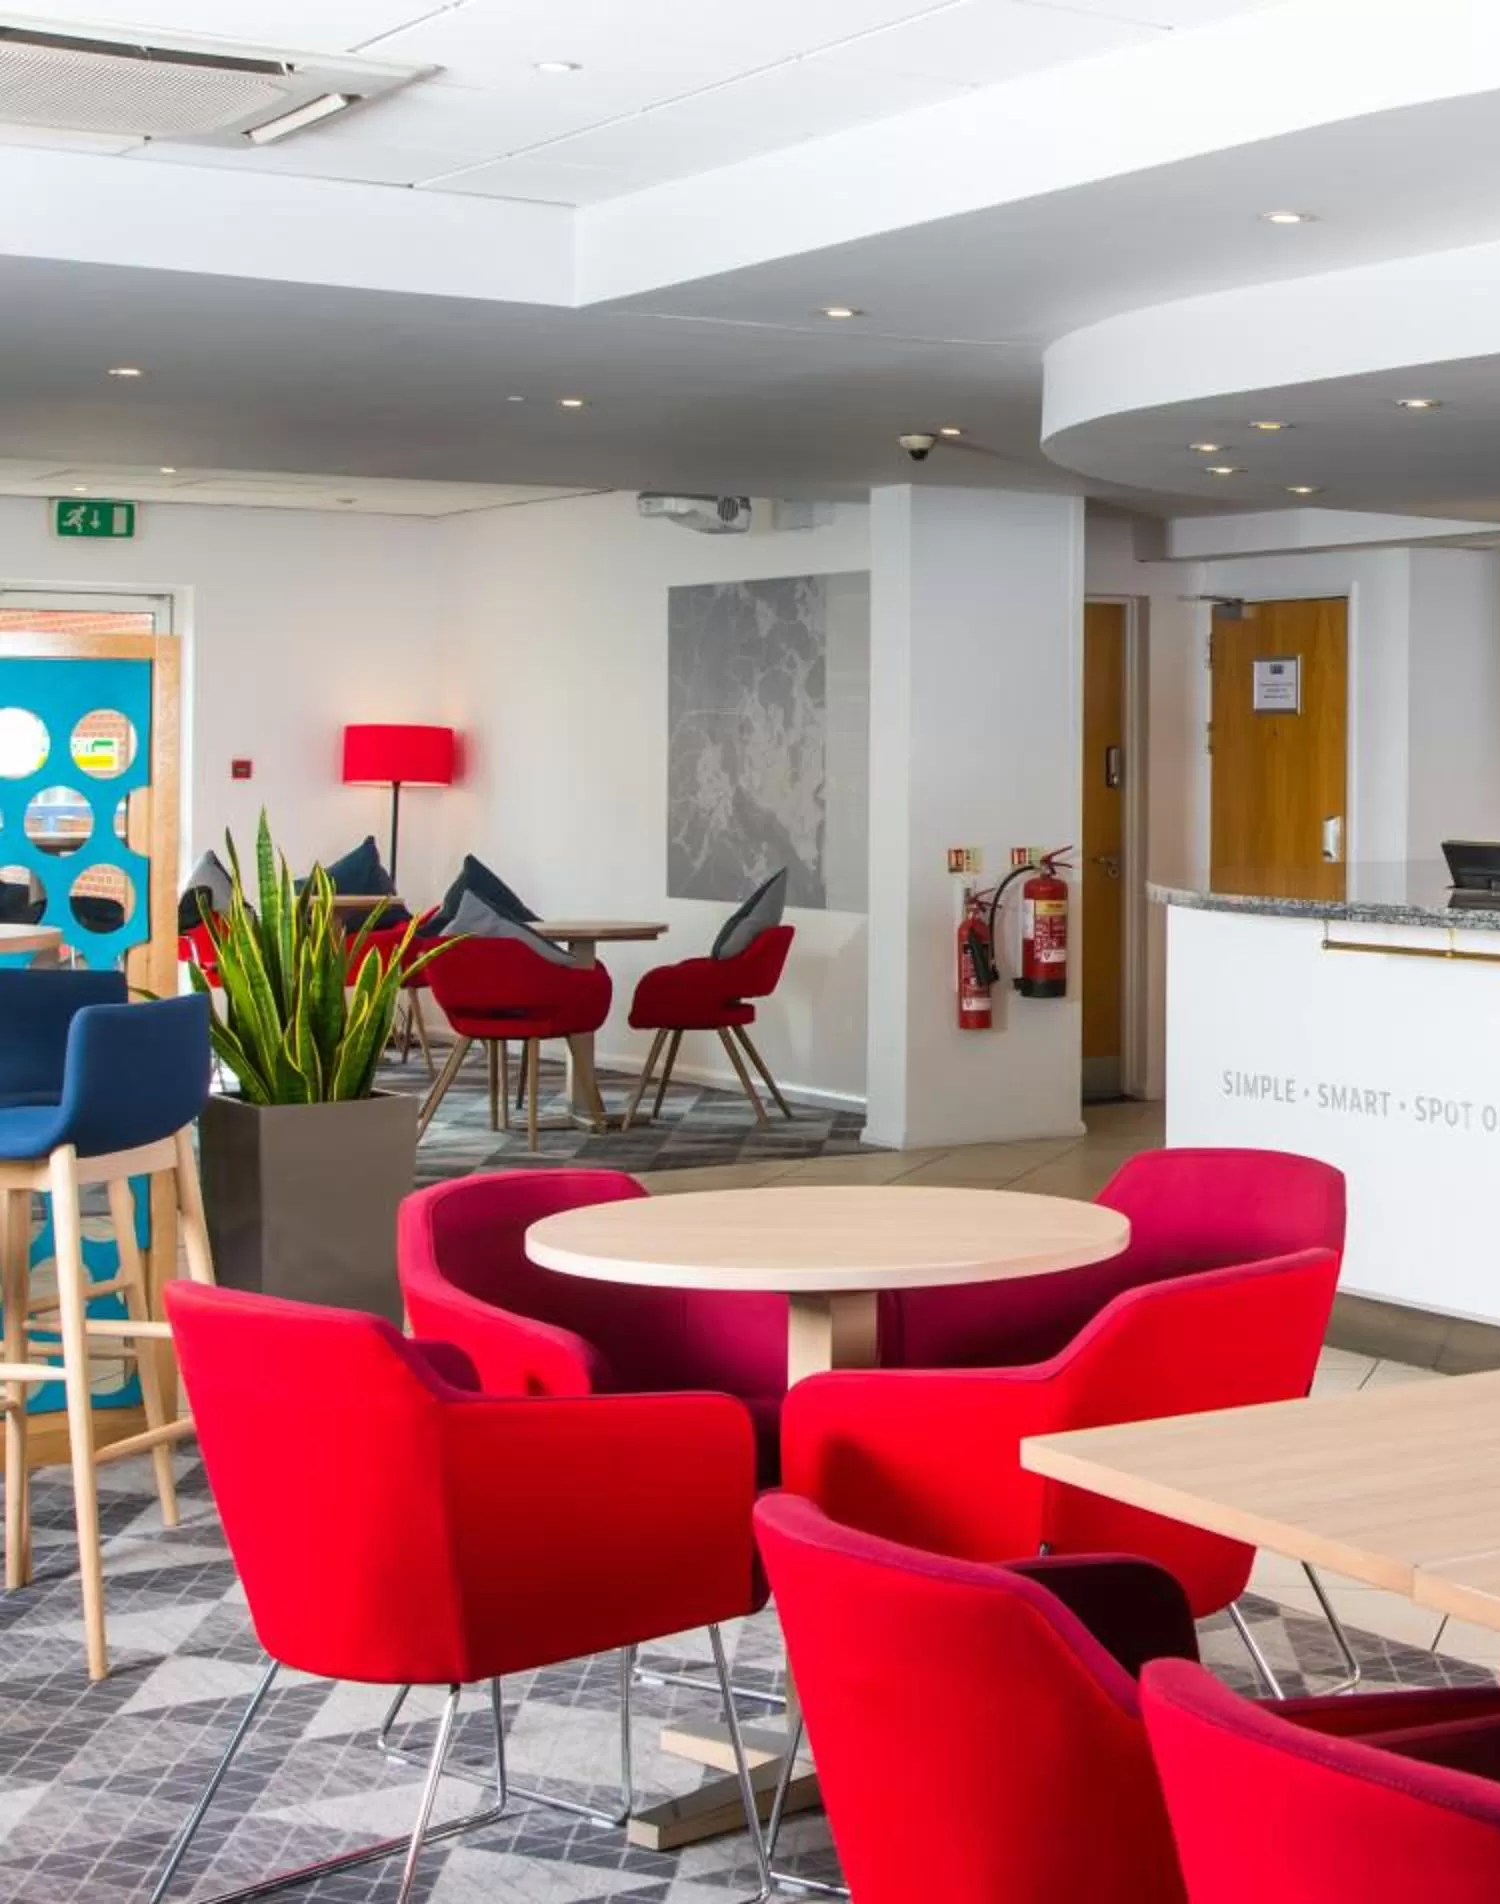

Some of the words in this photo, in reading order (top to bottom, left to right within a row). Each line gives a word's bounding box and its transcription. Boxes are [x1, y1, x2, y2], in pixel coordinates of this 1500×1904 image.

[1222, 1069, 1297, 1103] SIMPLE
[1317, 1083, 1392, 1118] SMART
[1415, 1095, 1473, 1129] SPOT
